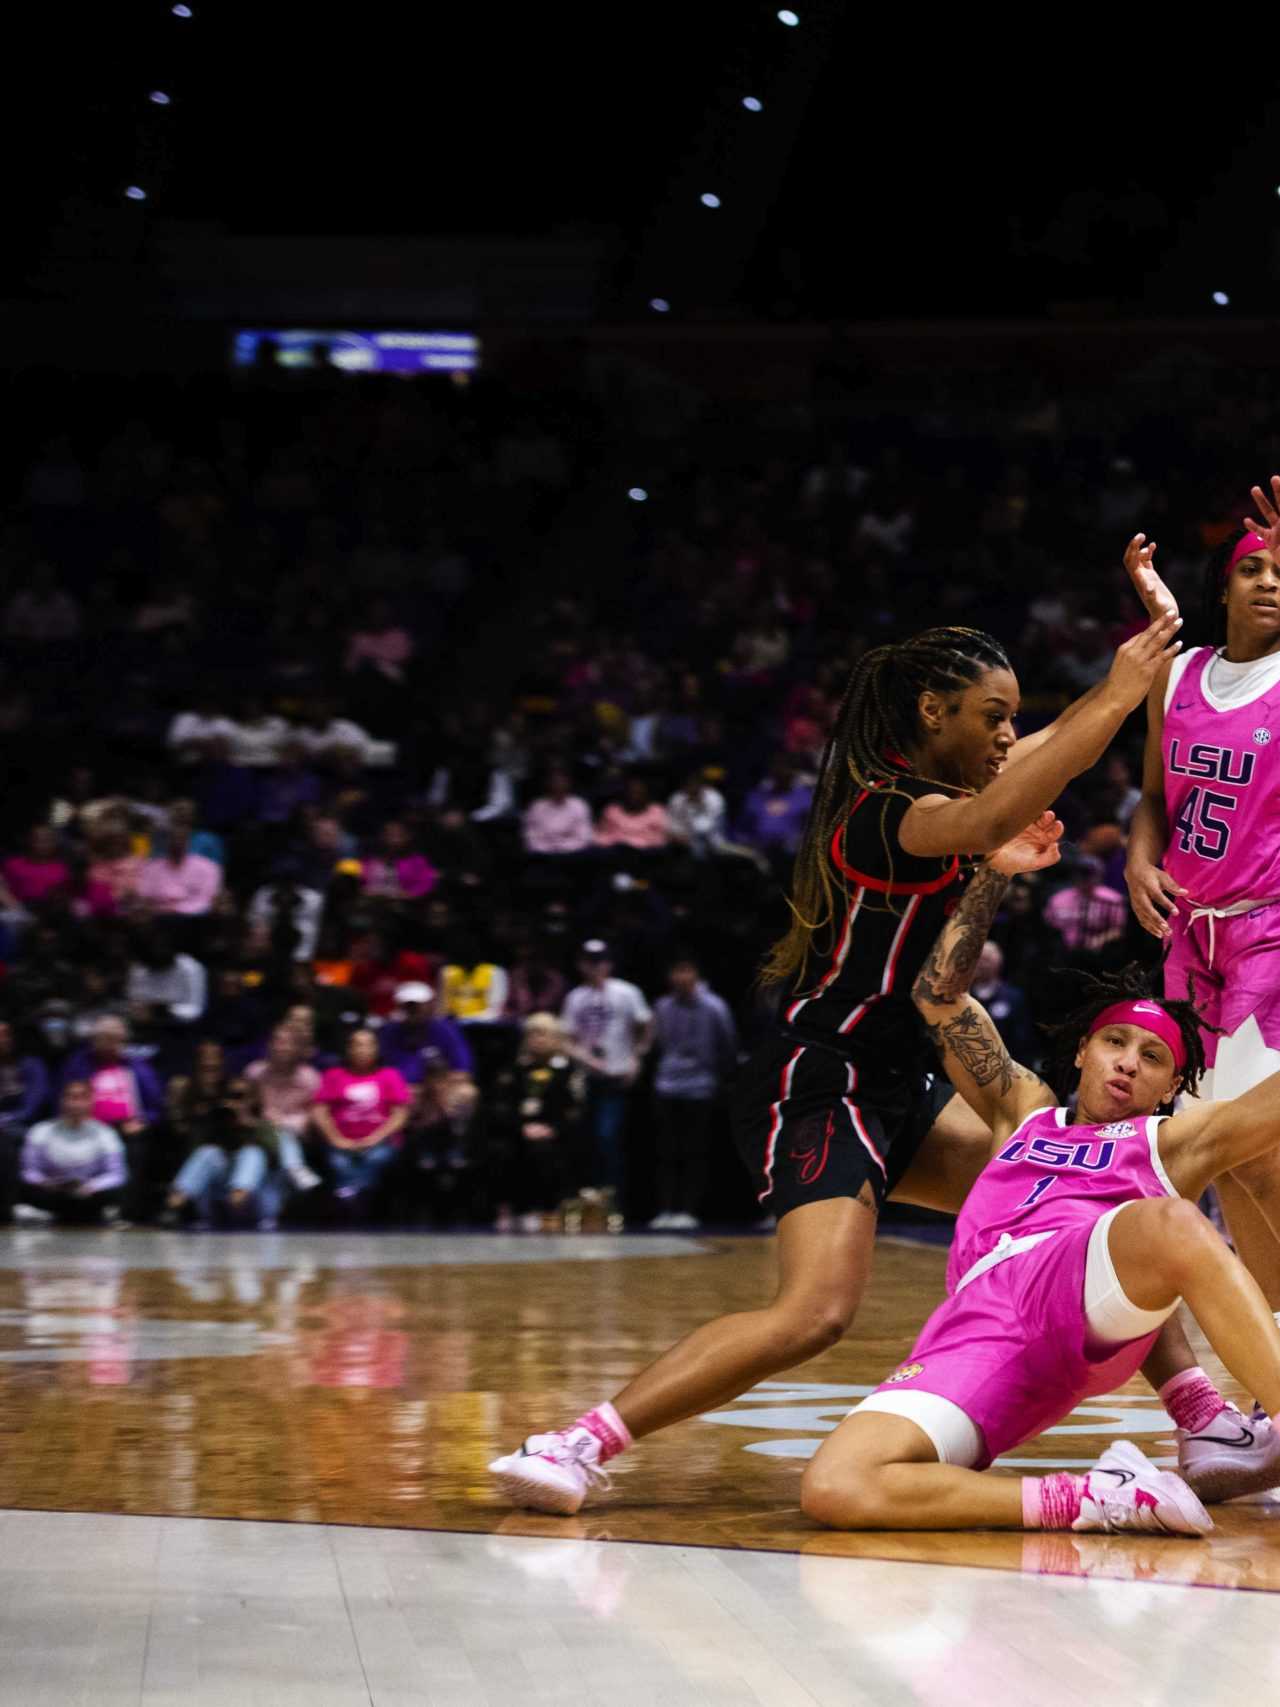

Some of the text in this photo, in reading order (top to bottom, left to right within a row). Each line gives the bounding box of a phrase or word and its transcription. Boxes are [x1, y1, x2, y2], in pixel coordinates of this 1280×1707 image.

[1169, 738, 1256, 787] LSU
[1175, 784, 1237, 862] 45
[996, 1137, 1117, 1172] LSU
[1016, 1174, 1058, 1210] 1
